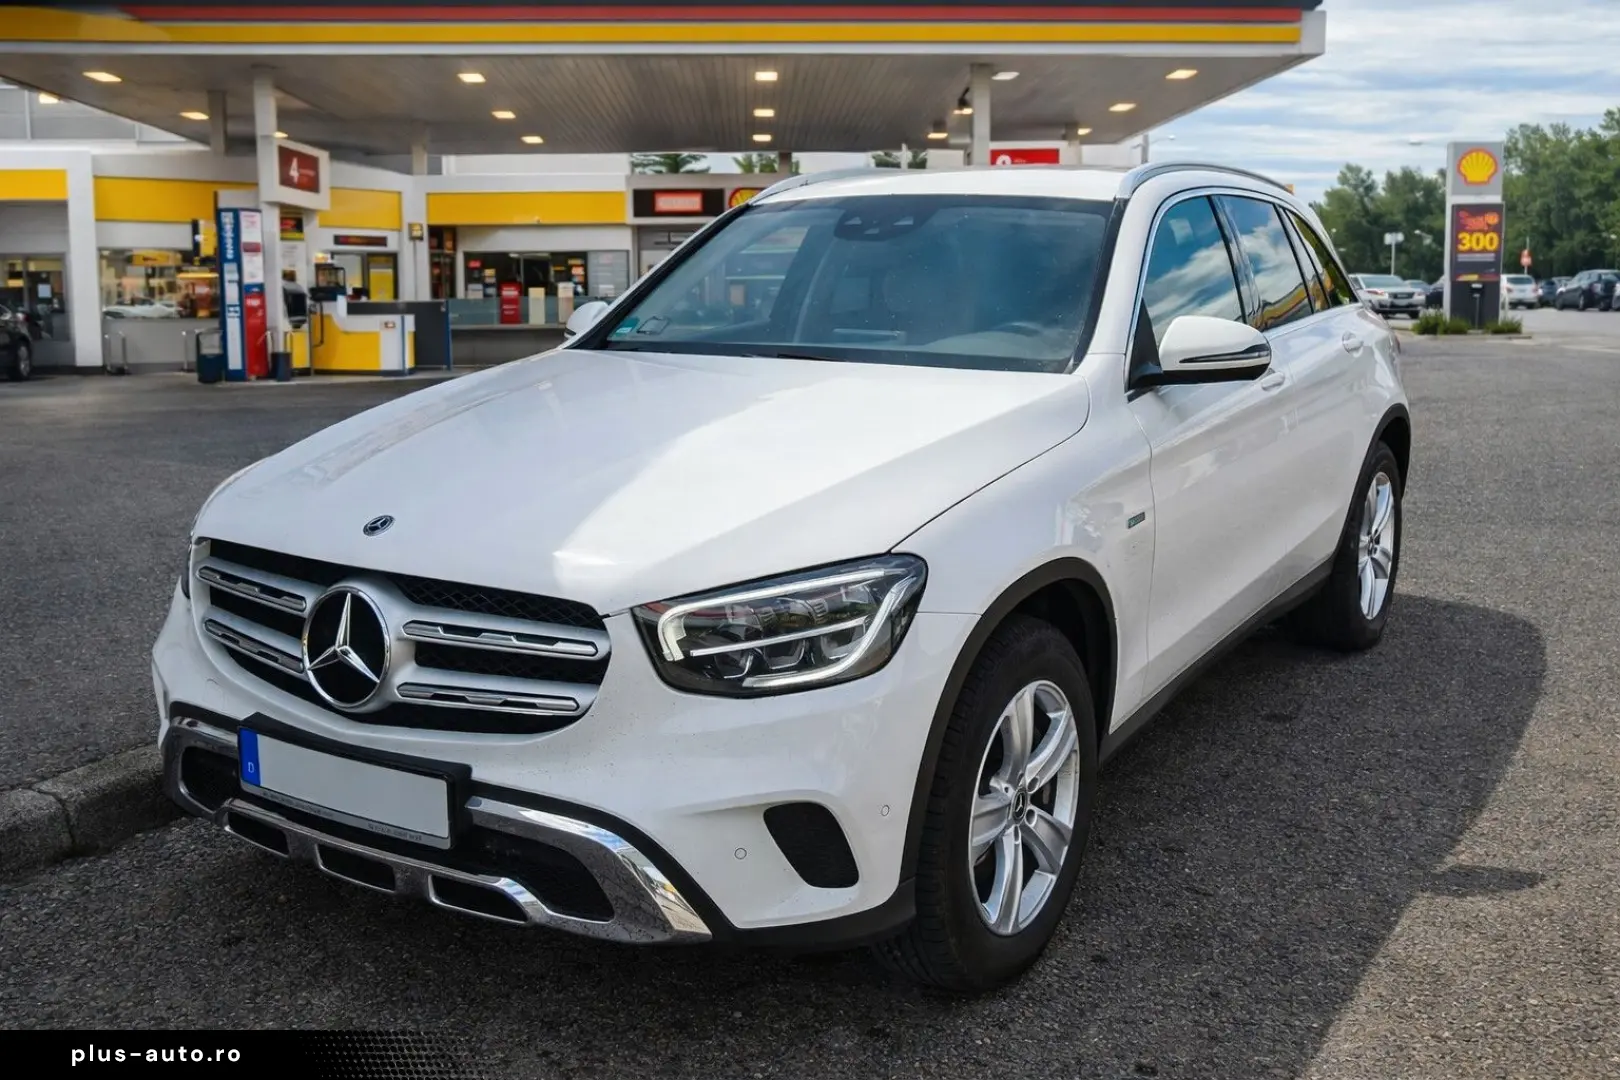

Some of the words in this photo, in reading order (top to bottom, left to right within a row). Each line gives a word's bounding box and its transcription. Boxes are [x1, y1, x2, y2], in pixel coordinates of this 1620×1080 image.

[289, 157, 300, 184] 4
[1457, 232, 1499, 251] 300
[248, 761, 255, 773] D
